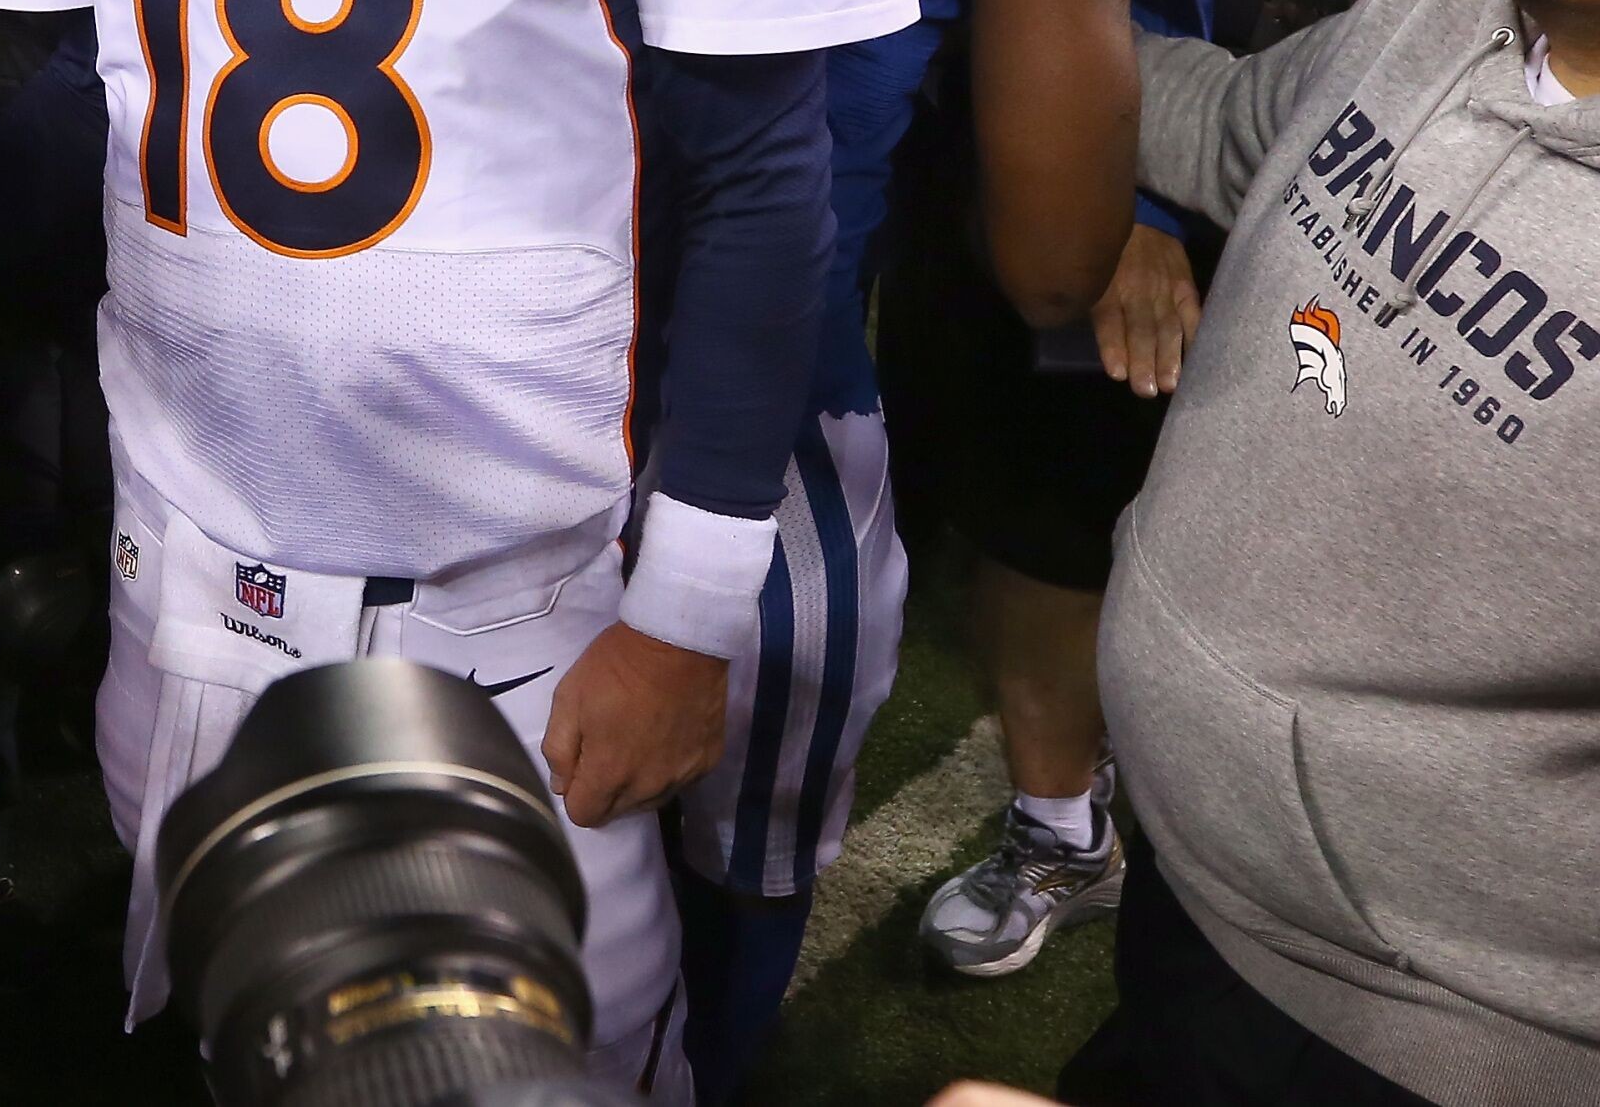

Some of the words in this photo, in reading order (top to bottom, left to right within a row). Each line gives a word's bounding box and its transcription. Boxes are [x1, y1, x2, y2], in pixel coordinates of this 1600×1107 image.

[1284, 175, 1400, 329] STABLISHE
[1400, 327, 1438, 366] IN
[1439, 365, 1524, 444] 1960
[1308, 100, 1600, 401] BNCOS
[117, 547, 137, 576] NFL
[240, 580, 280, 617] NFL
